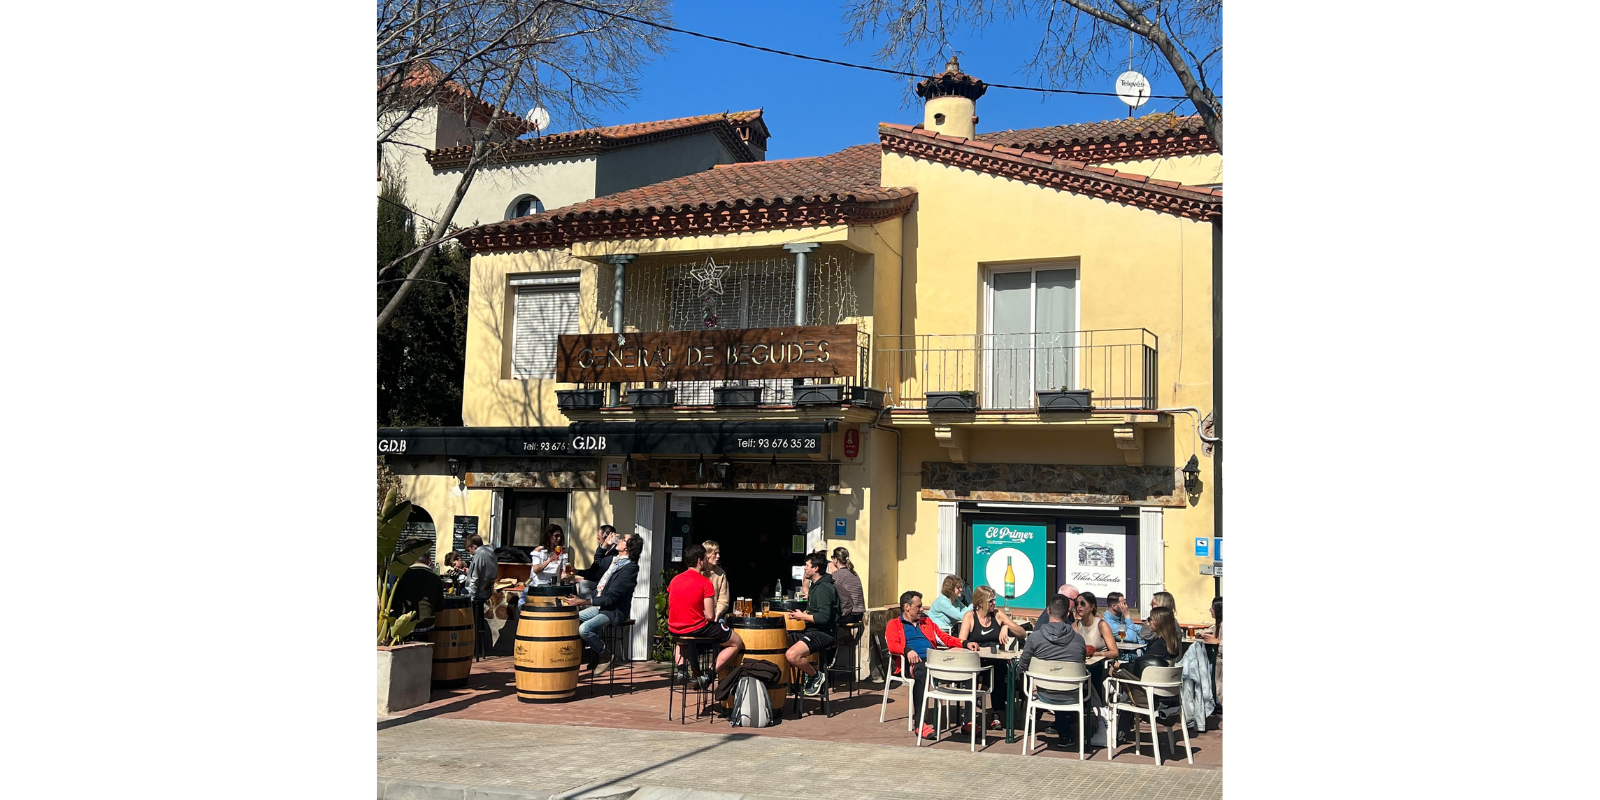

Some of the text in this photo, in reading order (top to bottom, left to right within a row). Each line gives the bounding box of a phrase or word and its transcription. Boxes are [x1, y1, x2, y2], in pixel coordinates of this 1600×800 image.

[578, 340, 830, 369] GENERAL DE BEGUDES
[378, 439, 407, 452] G.D.B
[540, 441, 550, 451] 93
[551, 441, 566, 451] 676
[572, 436, 607, 450] G.D.B
[737, 438, 816, 449] Telf: 93 676 35 28
[985, 526, 1034, 543] El Primer
